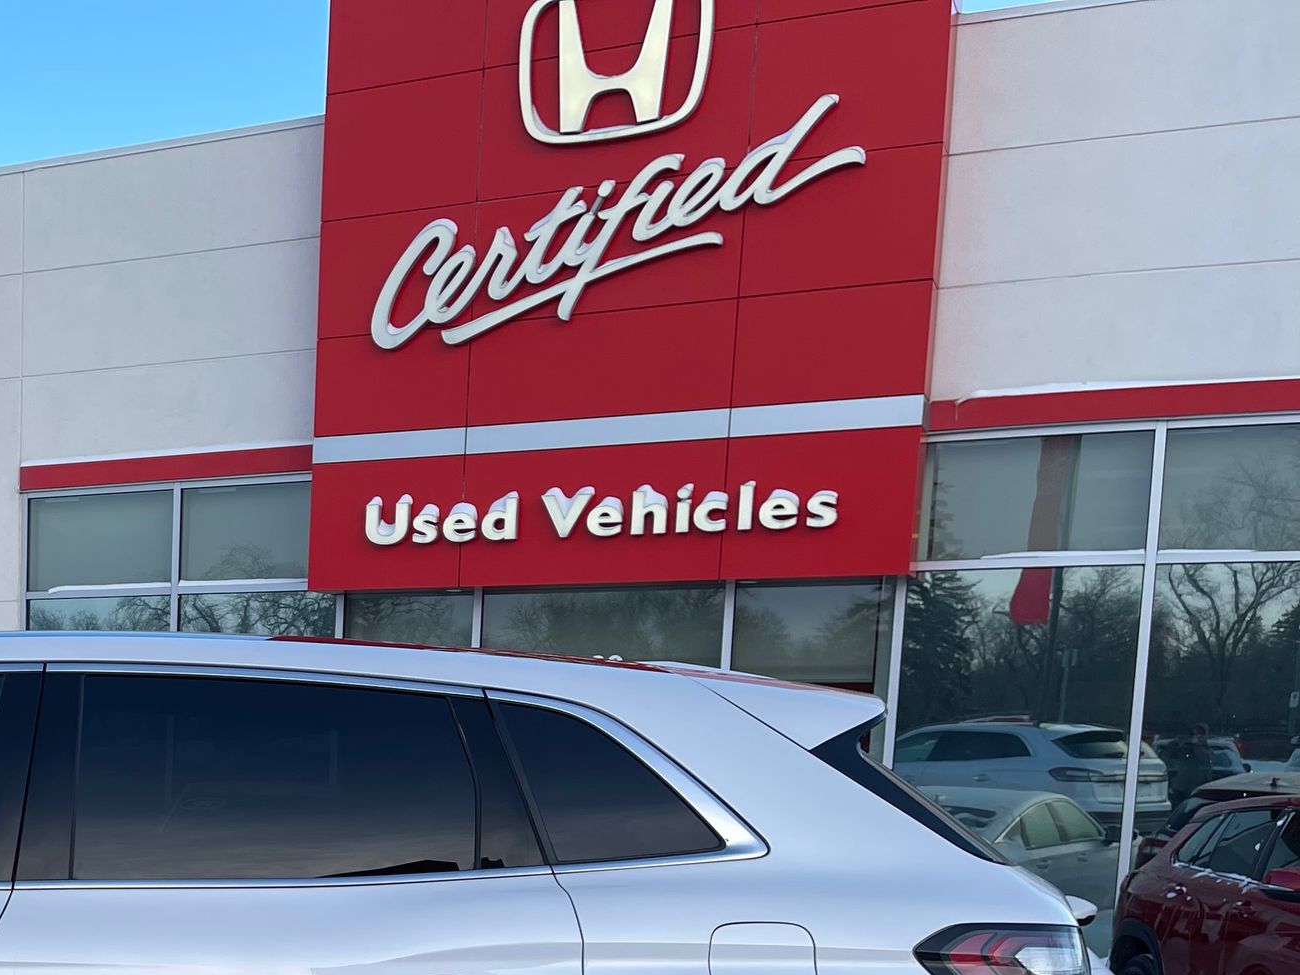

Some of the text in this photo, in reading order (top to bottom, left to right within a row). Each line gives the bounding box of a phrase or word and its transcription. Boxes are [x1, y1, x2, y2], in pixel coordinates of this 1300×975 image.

[371, 94, 866, 350] Certified
[365, 481, 839, 546] Used Vehicles
